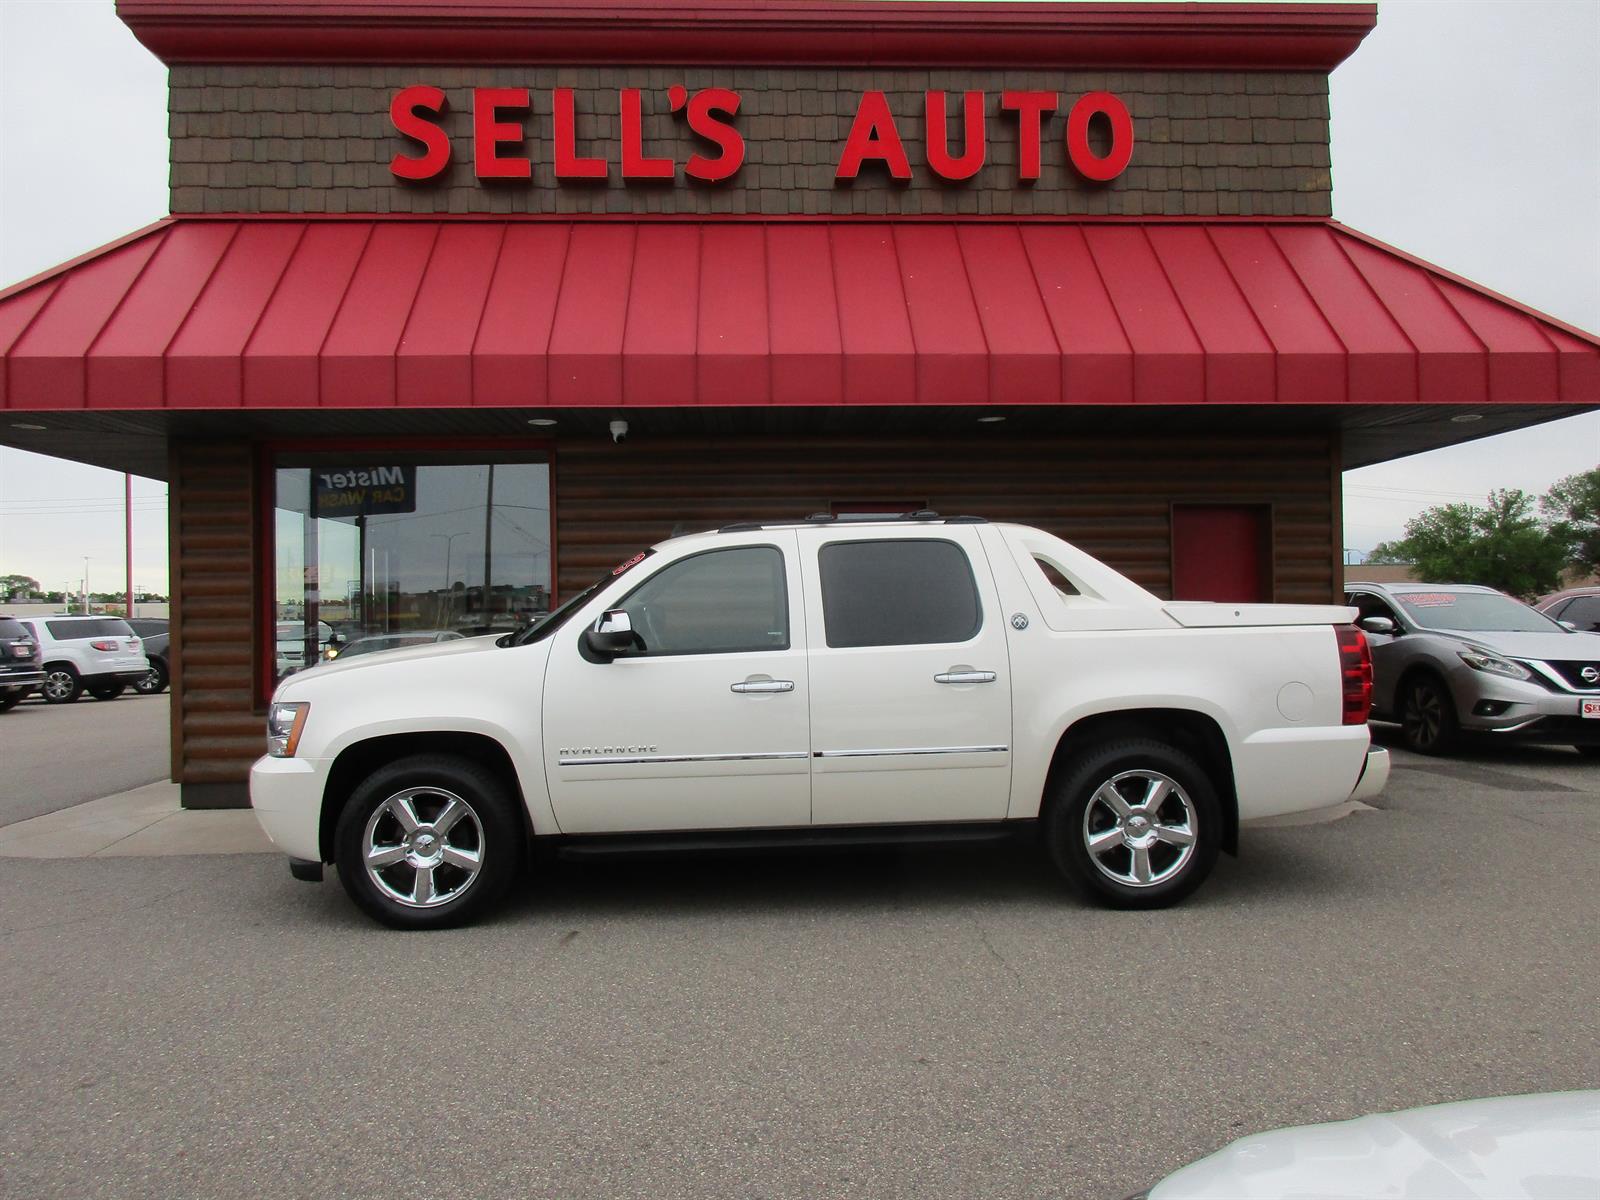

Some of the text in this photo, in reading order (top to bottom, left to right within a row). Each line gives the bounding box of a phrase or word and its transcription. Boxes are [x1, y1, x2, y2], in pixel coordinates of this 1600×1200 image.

[390, 85, 1134, 181] SELL'S AUTO
[559, 744, 658, 756] AVALANCHE
